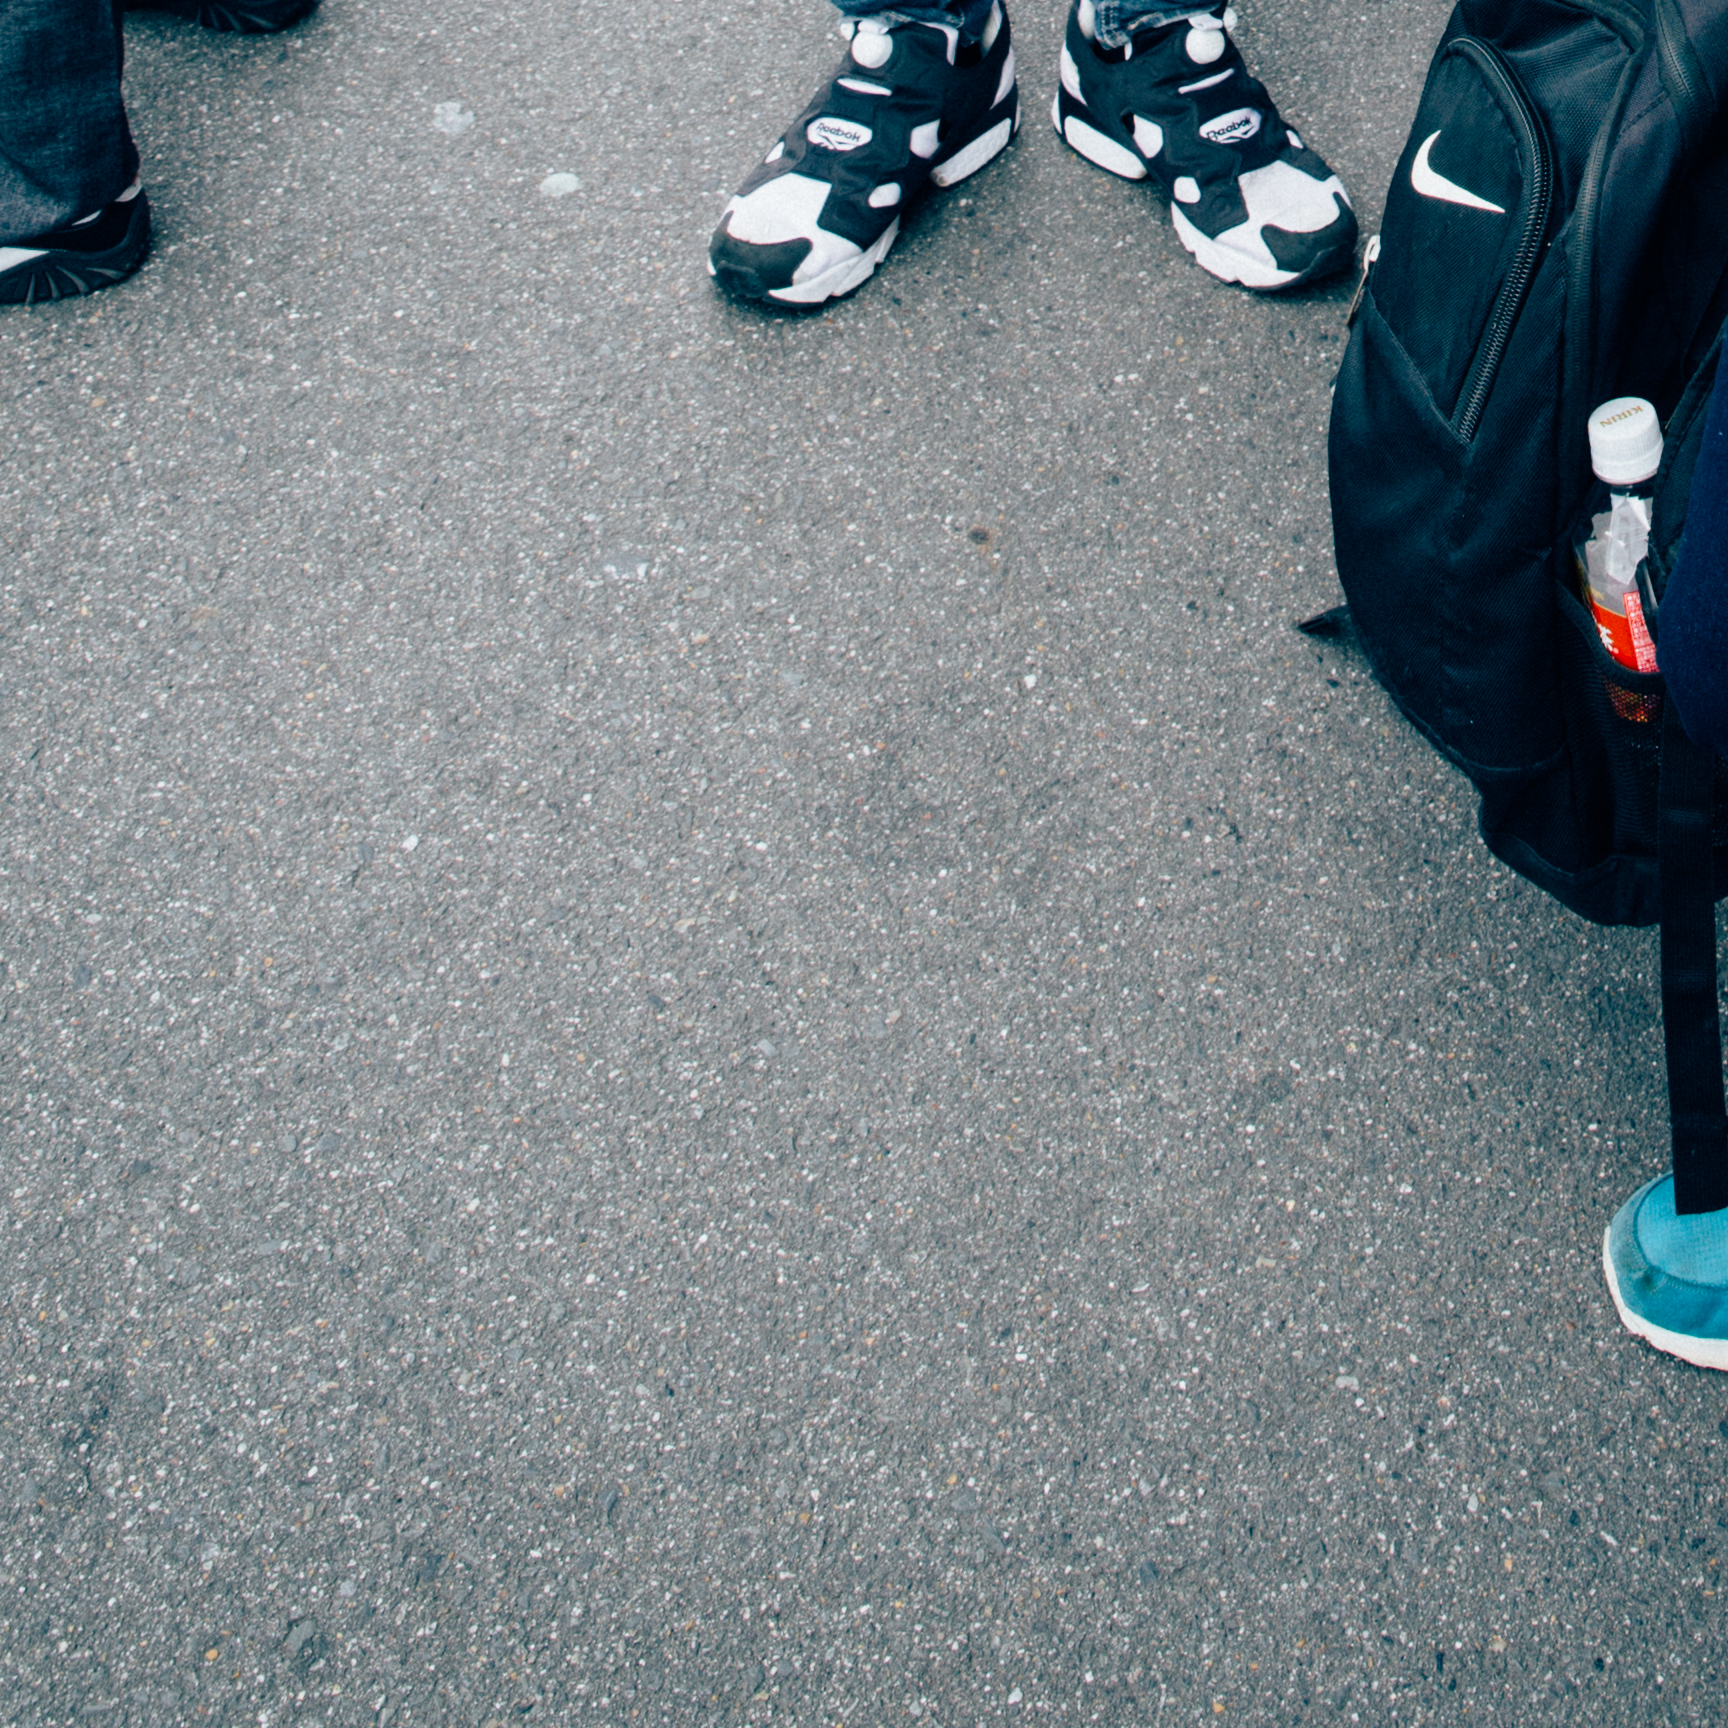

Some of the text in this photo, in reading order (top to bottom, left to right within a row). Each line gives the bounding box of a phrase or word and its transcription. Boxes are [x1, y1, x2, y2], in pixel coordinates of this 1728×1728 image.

[816, 122, 860, 142] Reebok
[1206, 116, 1252, 141] Reebok
[1599, 405, 1643, 428] KIRIN
